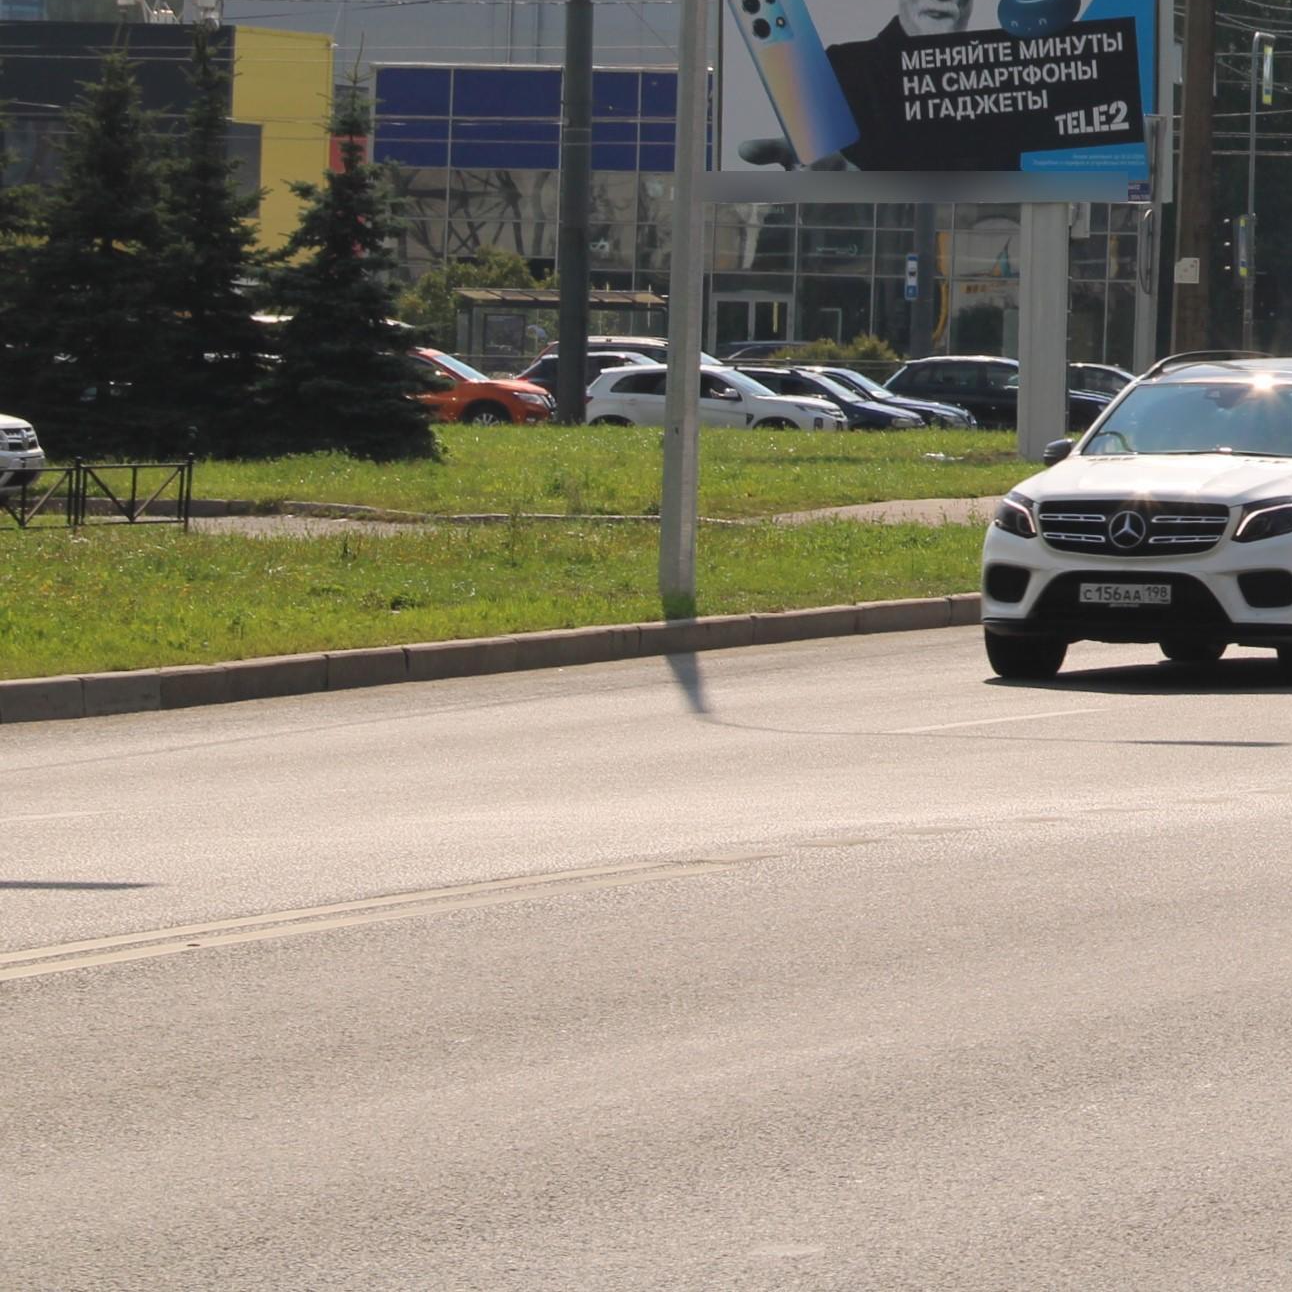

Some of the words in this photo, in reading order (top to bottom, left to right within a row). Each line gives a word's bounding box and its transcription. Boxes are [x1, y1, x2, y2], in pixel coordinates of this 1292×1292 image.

[901, 40, 1013, 71] МЕНЯЙТЕ
[1019, 32, 1123, 59] МИНУТЫ
[903, 75, 936, 96] НА
[941, 60, 1098, 92] СМАРТФОНЫ
[905, 101, 922, 121] И
[928, 89, 1049, 121] ГАДЖЕТЫ
[1054, 100, 1130, 135] TELE2
